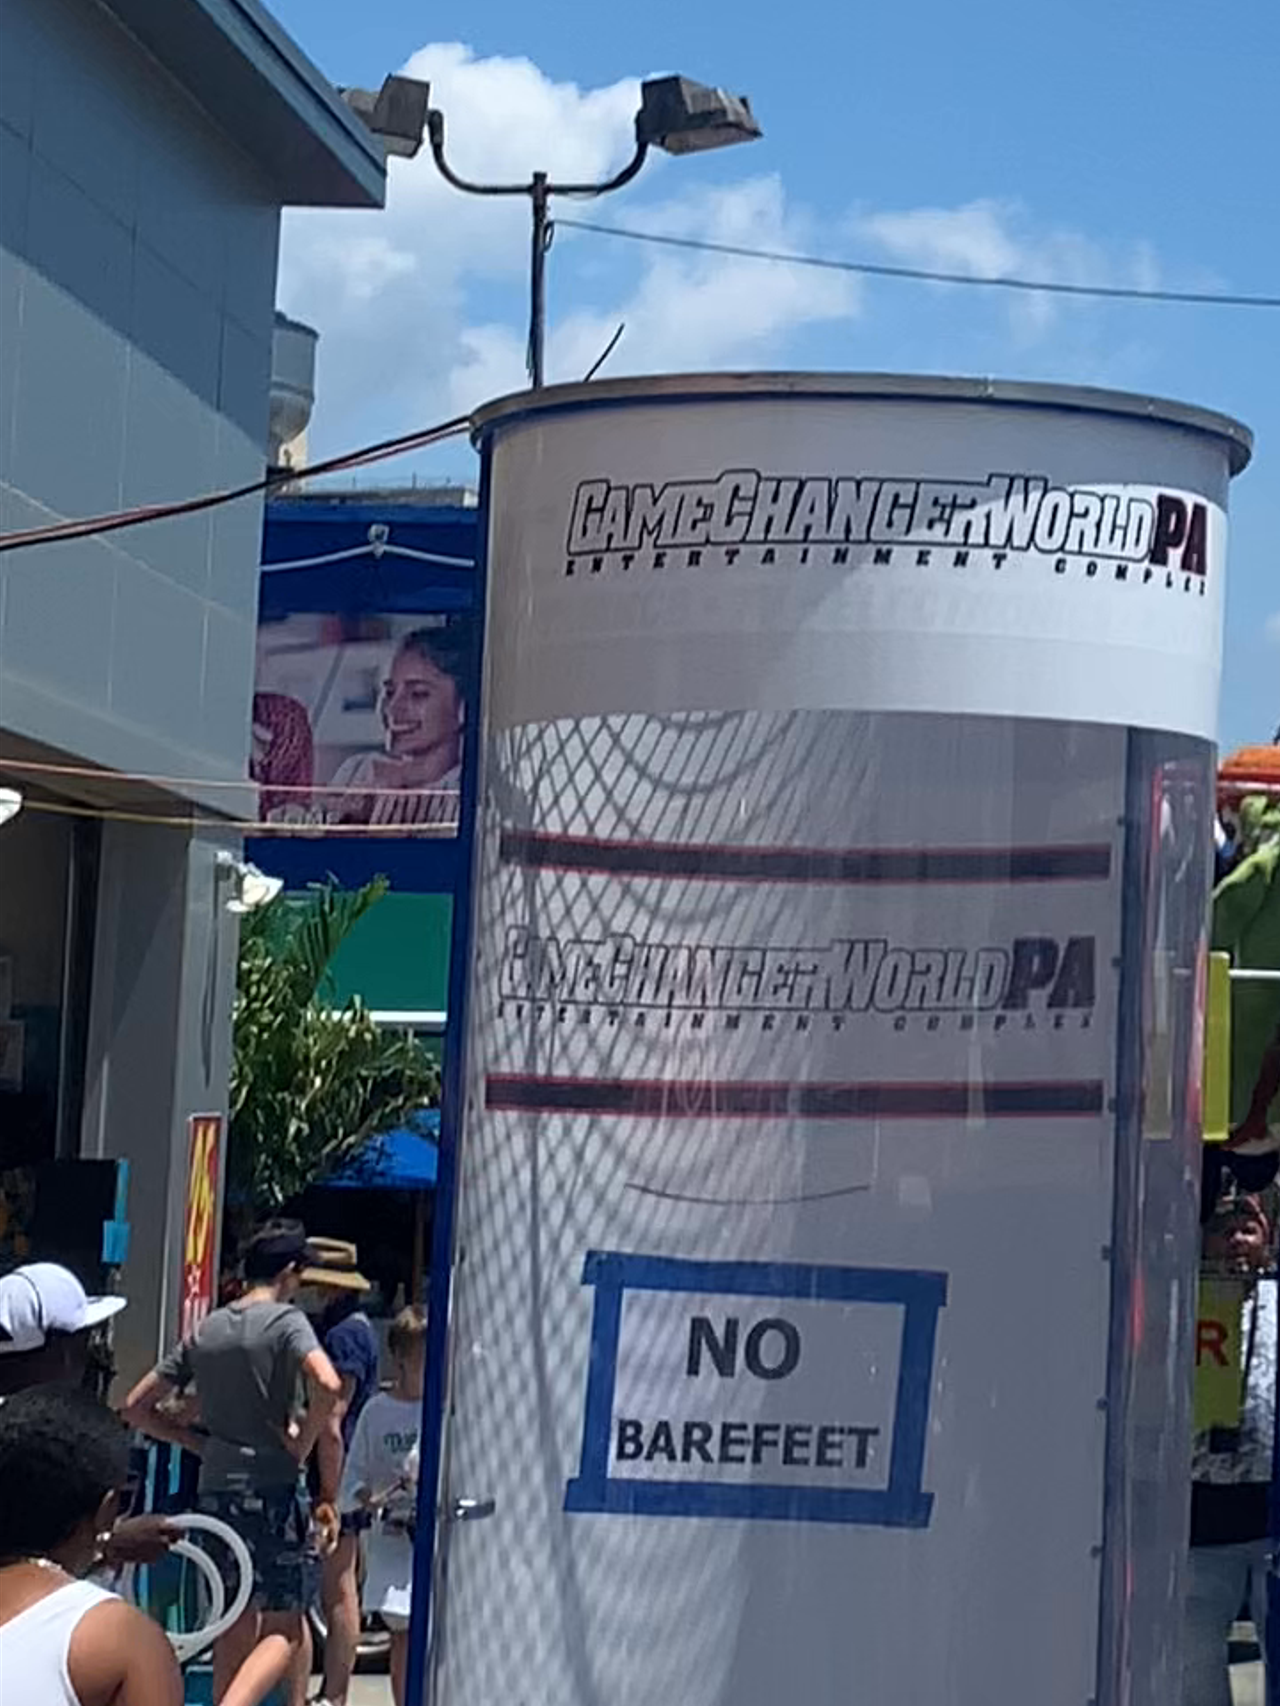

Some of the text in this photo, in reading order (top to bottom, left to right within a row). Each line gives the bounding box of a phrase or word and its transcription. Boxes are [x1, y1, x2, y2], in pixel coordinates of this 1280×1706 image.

[566, 547, 1006, 575] ENTERTAINMENT
[686, 1316, 801, 1381] NO
[615, 1418, 880, 1469] BAREFEET
